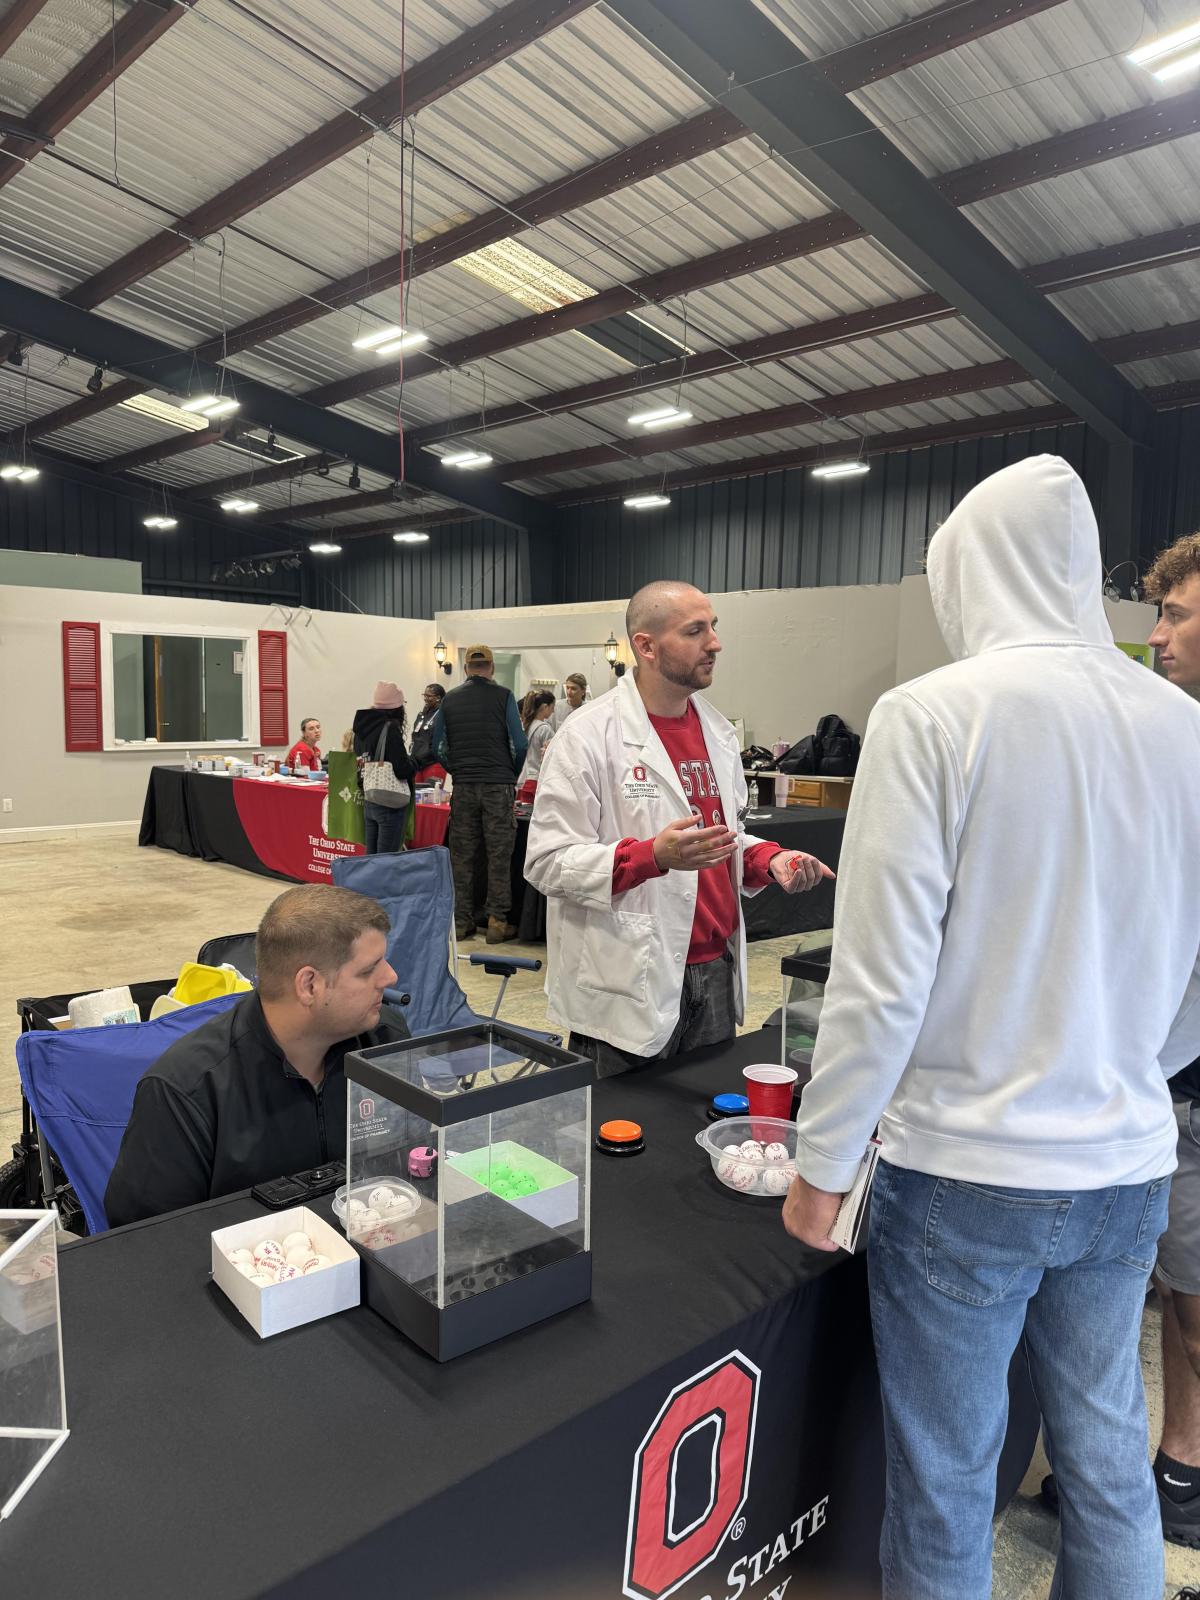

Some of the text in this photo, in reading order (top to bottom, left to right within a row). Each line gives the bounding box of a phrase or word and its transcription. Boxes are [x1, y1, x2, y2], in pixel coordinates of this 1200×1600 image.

[308, 835, 356, 853] THE OHIO STATE
[358, 1098, 375, 1120] O
[725, 1495, 830, 1600] STATE
